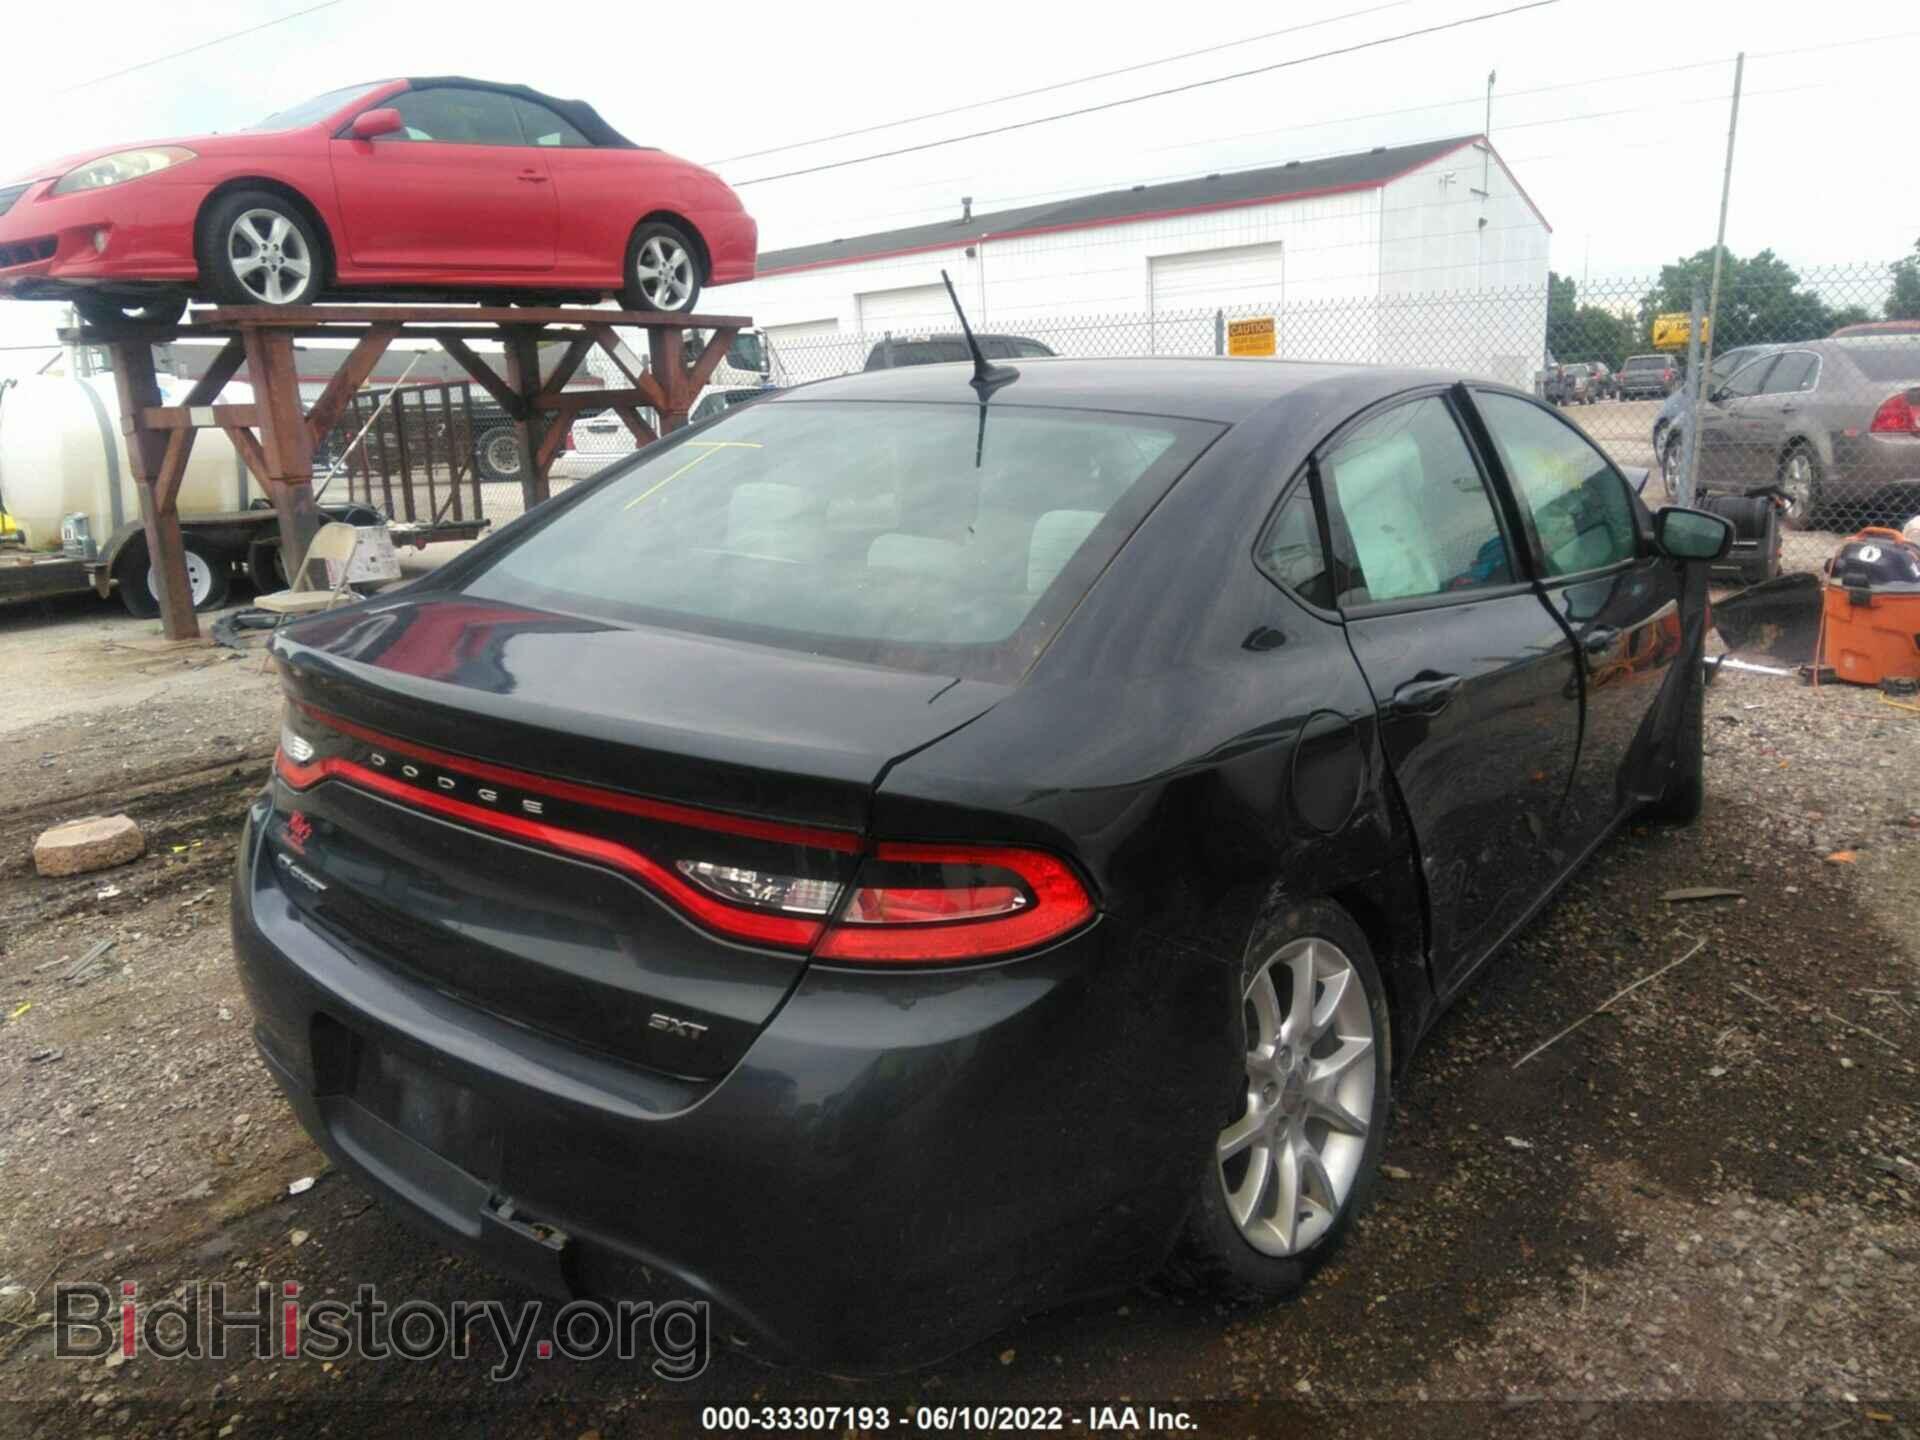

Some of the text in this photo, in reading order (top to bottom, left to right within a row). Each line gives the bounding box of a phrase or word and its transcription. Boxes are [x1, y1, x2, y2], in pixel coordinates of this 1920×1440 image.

[1230, 321, 1273, 336] CAUTION
[370, 752, 544, 815] DODGE
[648, 1012, 709, 1039] SXT
